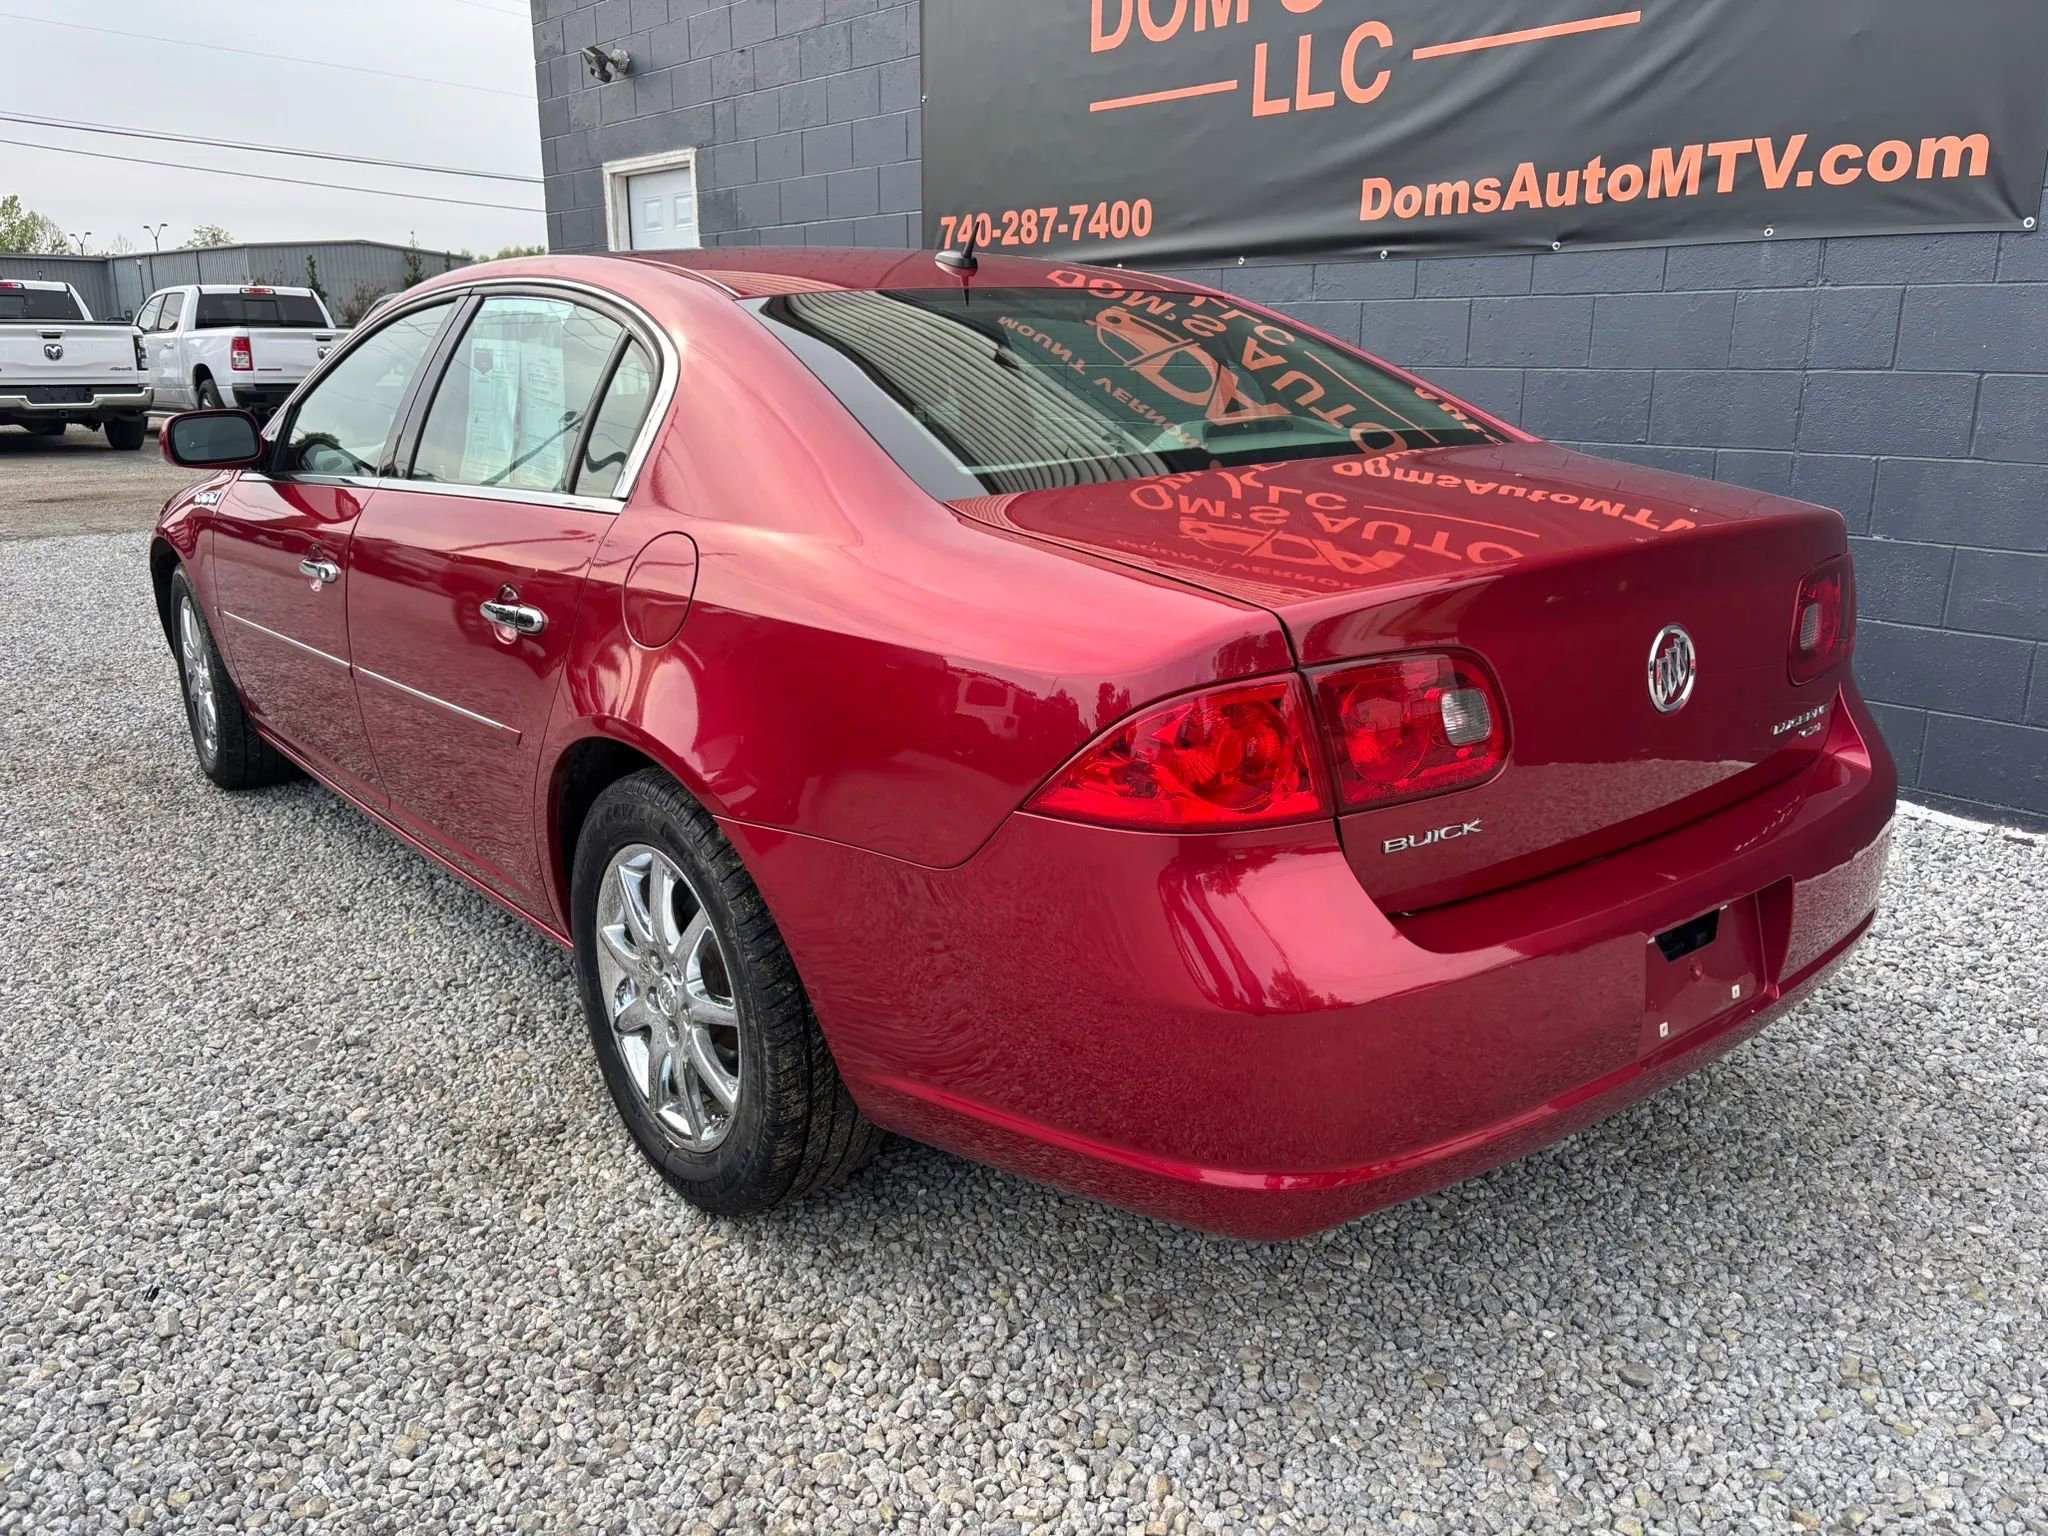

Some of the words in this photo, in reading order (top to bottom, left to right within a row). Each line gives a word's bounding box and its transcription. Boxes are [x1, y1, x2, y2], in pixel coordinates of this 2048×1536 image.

[1252, 20, 1393, 117] LLC
[1359, 132, 1991, 222] DomsAutoMTV.com
[940, 198, 1153, 250] 740-287-7400
[1382, 817, 1484, 855] BUICK
